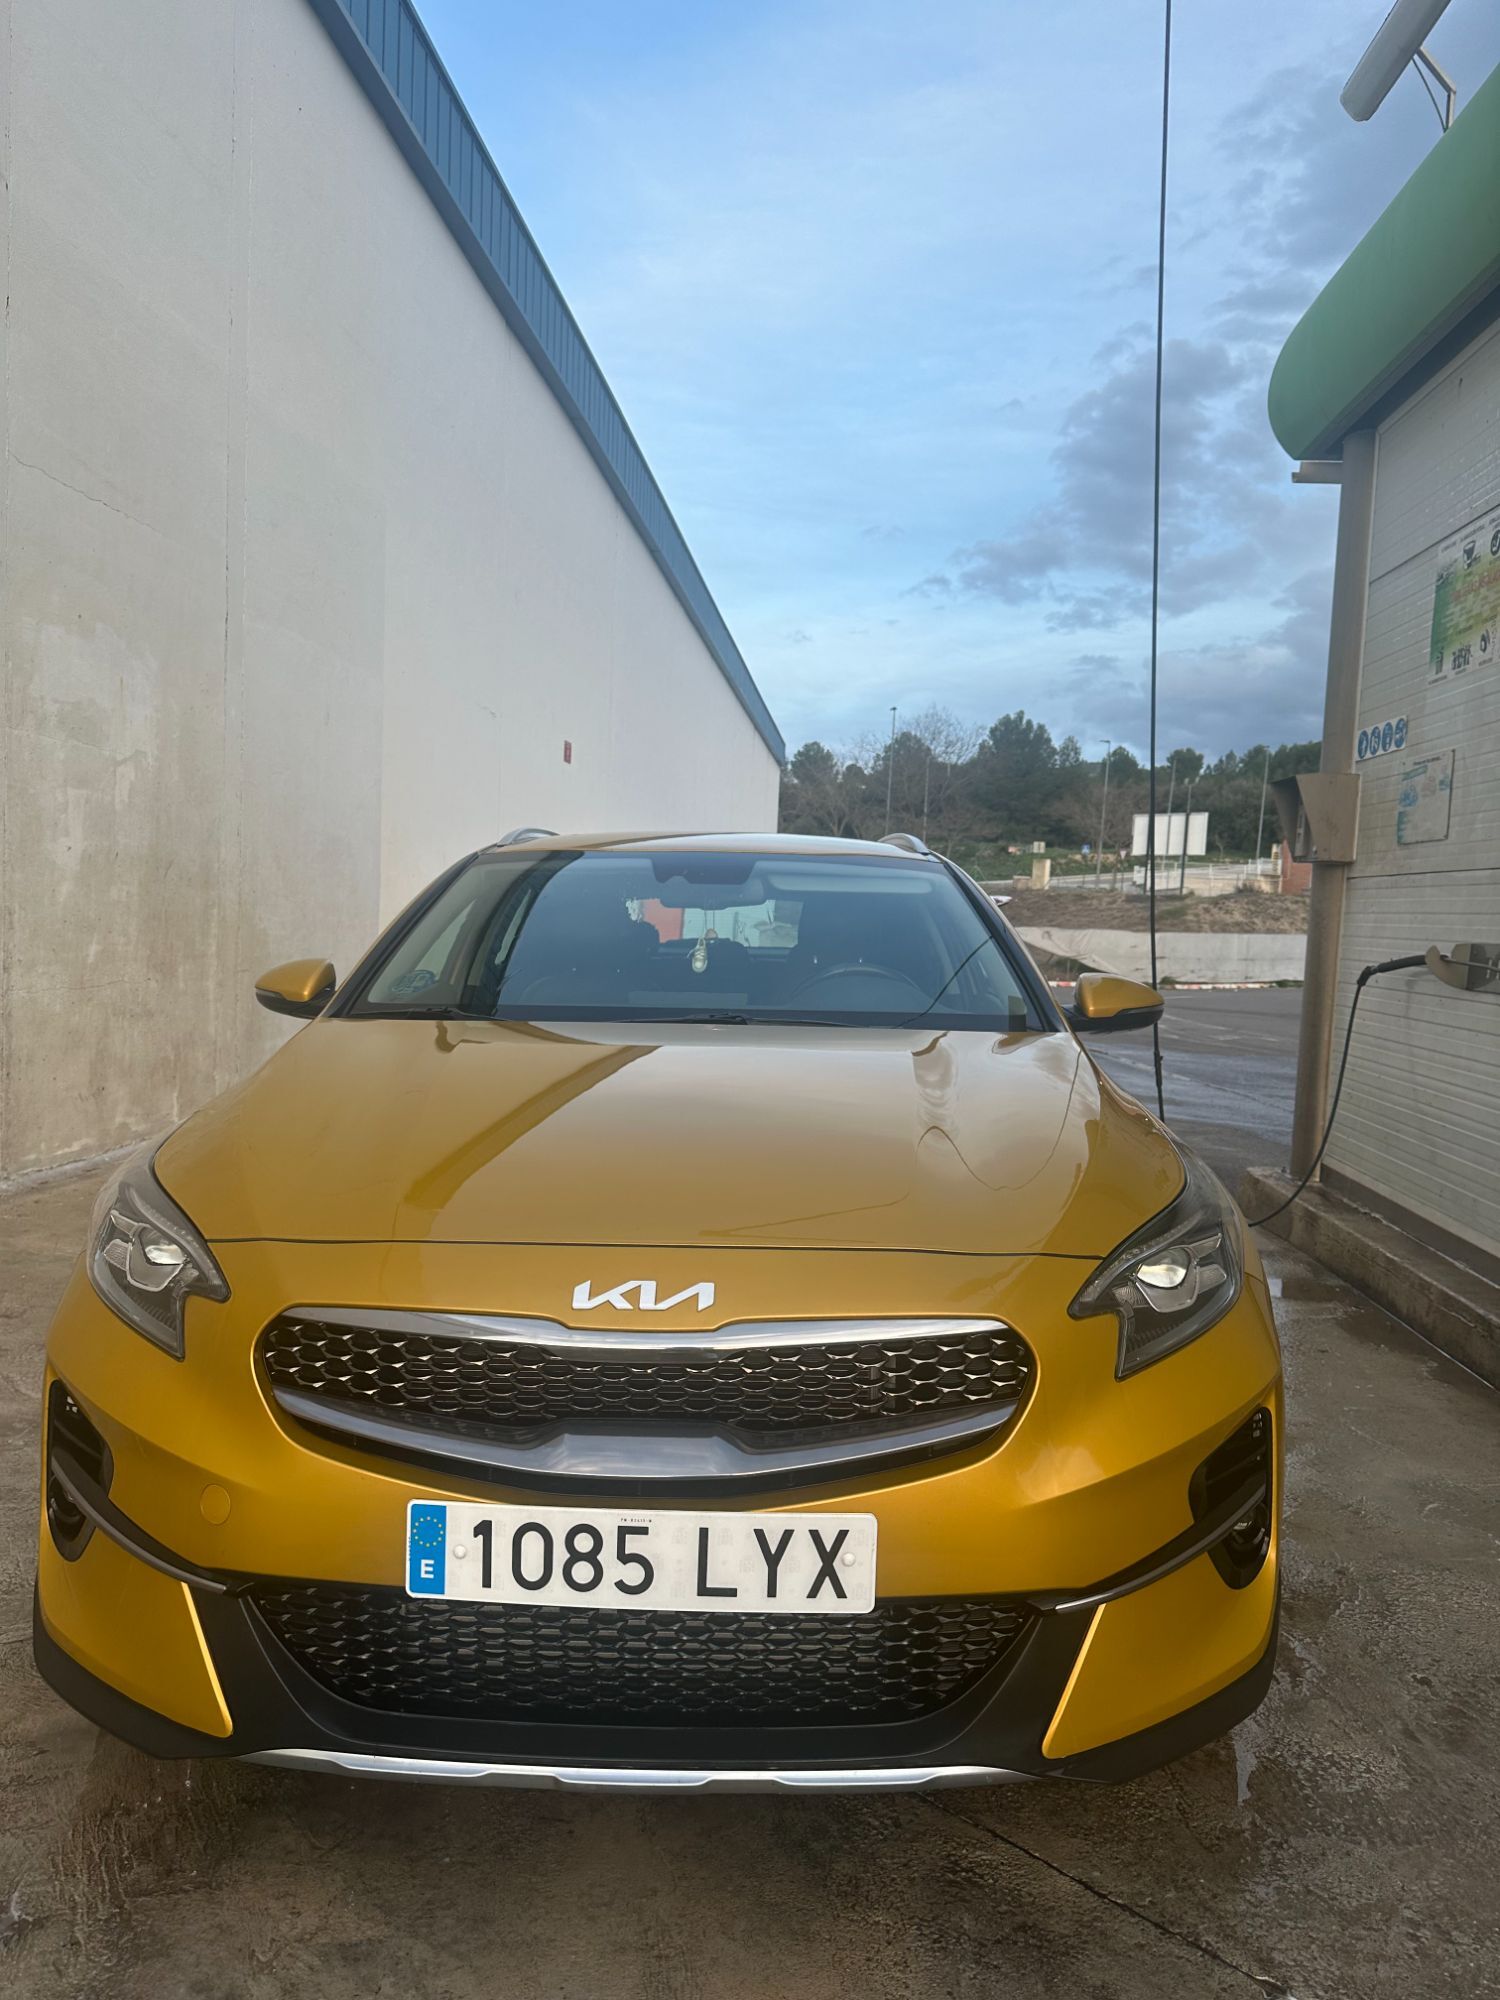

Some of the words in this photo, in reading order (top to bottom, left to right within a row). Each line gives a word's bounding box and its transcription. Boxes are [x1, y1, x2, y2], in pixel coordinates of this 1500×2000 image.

[572, 1280, 715, 1312] KIA
[420, 1559, 434, 1579] E
[472, 1519, 654, 1596] 1085
[697, 1527, 850, 1599] LYX
